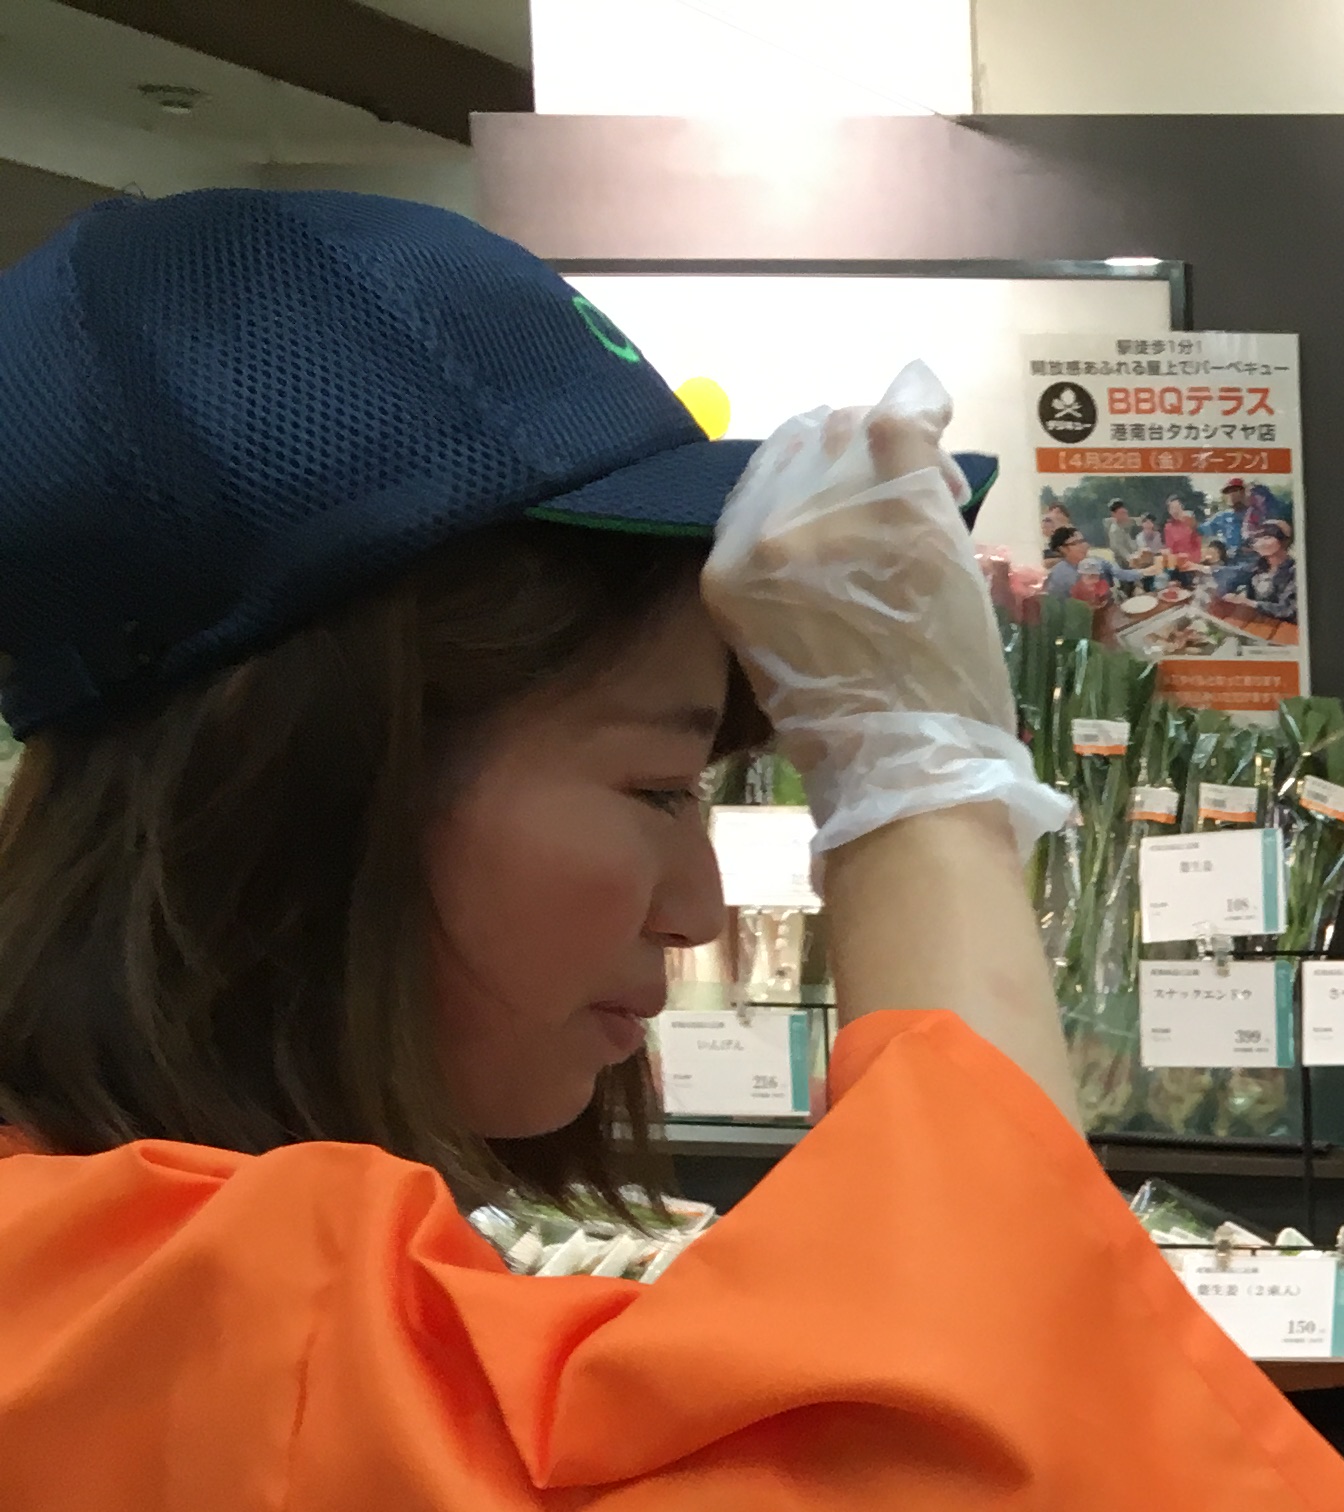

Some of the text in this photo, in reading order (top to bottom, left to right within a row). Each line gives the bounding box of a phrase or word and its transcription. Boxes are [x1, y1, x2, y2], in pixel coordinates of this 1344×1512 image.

[1107, 386, 1275, 416] BBQテラス
[1110, 423, 1277, 442] 港南台タカシマヤ店
[1288, 1320, 1316, 1334] 150
